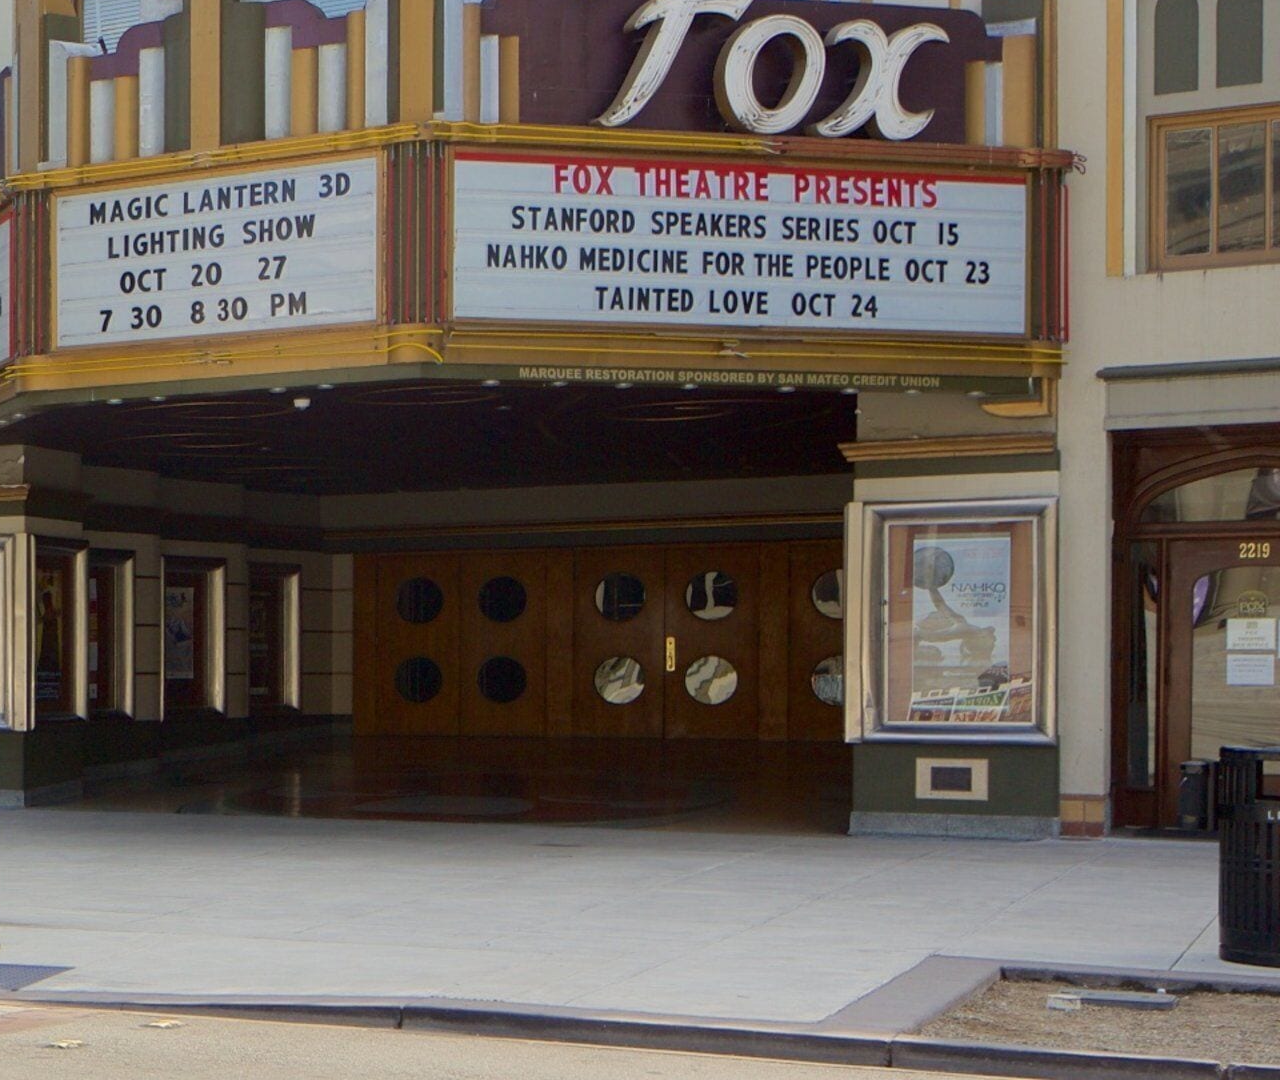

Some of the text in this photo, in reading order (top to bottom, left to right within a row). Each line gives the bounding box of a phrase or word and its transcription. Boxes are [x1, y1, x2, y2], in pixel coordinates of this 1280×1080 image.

[89, 172, 351, 225] MAGIC LANTERN 3D
[555, 165, 938, 208] FOX THEATRE PRESENTS
[107, 213, 316, 259] LIGHTING SHOW
[511, 206, 959, 246] STANFORD SPEAKERS SERIES OCT 15
[119, 256, 288, 294] OCT 20 27
[487, 244, 991, 284] NAHKO MEDICINE FOR THE PEOPLE OCT 23
[100, 292, 308, 333] 7 30 8 30 PM
[596, 286, 878, 318] TAINTED LOVE OCT 24
[519, 367, 939, 387] MARQUEE RESTORATION SPONSORED BY SAN MATEO CREDIT UNION
[1239, 542, 1271, 558] 2219
